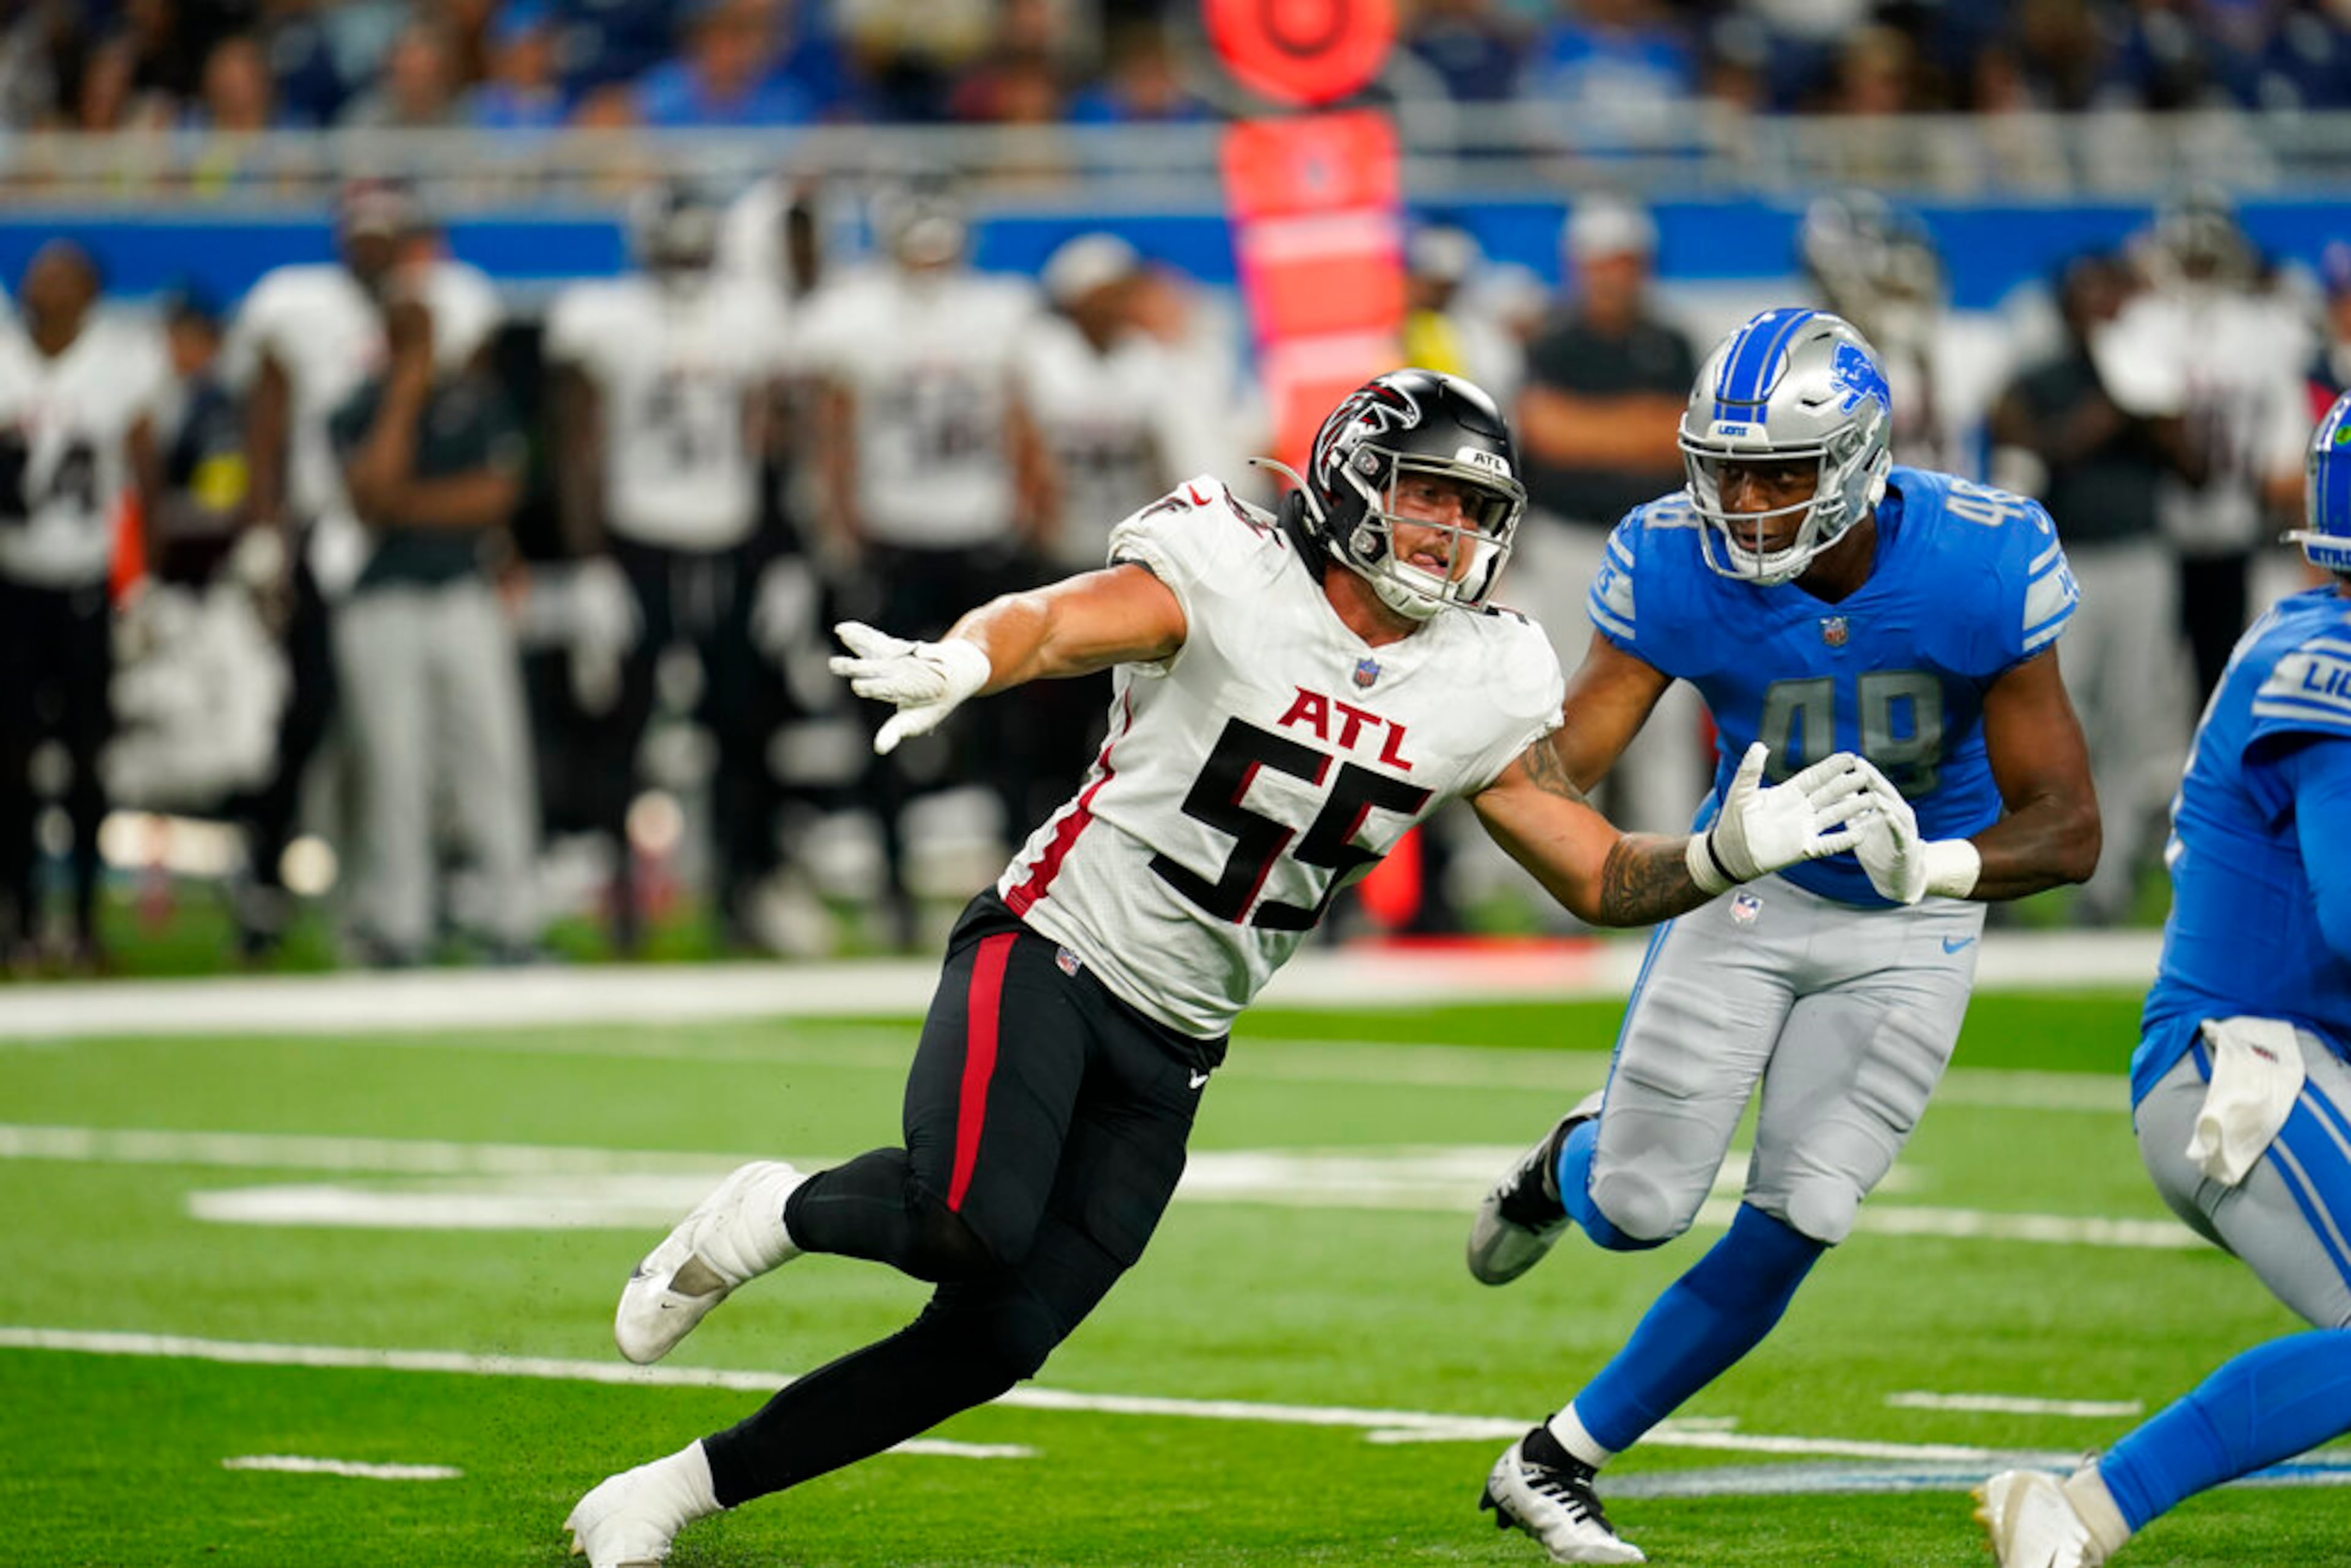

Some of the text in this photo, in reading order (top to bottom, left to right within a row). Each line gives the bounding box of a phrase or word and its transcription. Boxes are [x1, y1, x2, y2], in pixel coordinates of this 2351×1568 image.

[1474, 452, 1502, 470] ATL
[1277, 685, 1414, 772] ATL
[1757, 671, 1942, 796] 48
[1148, 715, 1436, 932] 55
